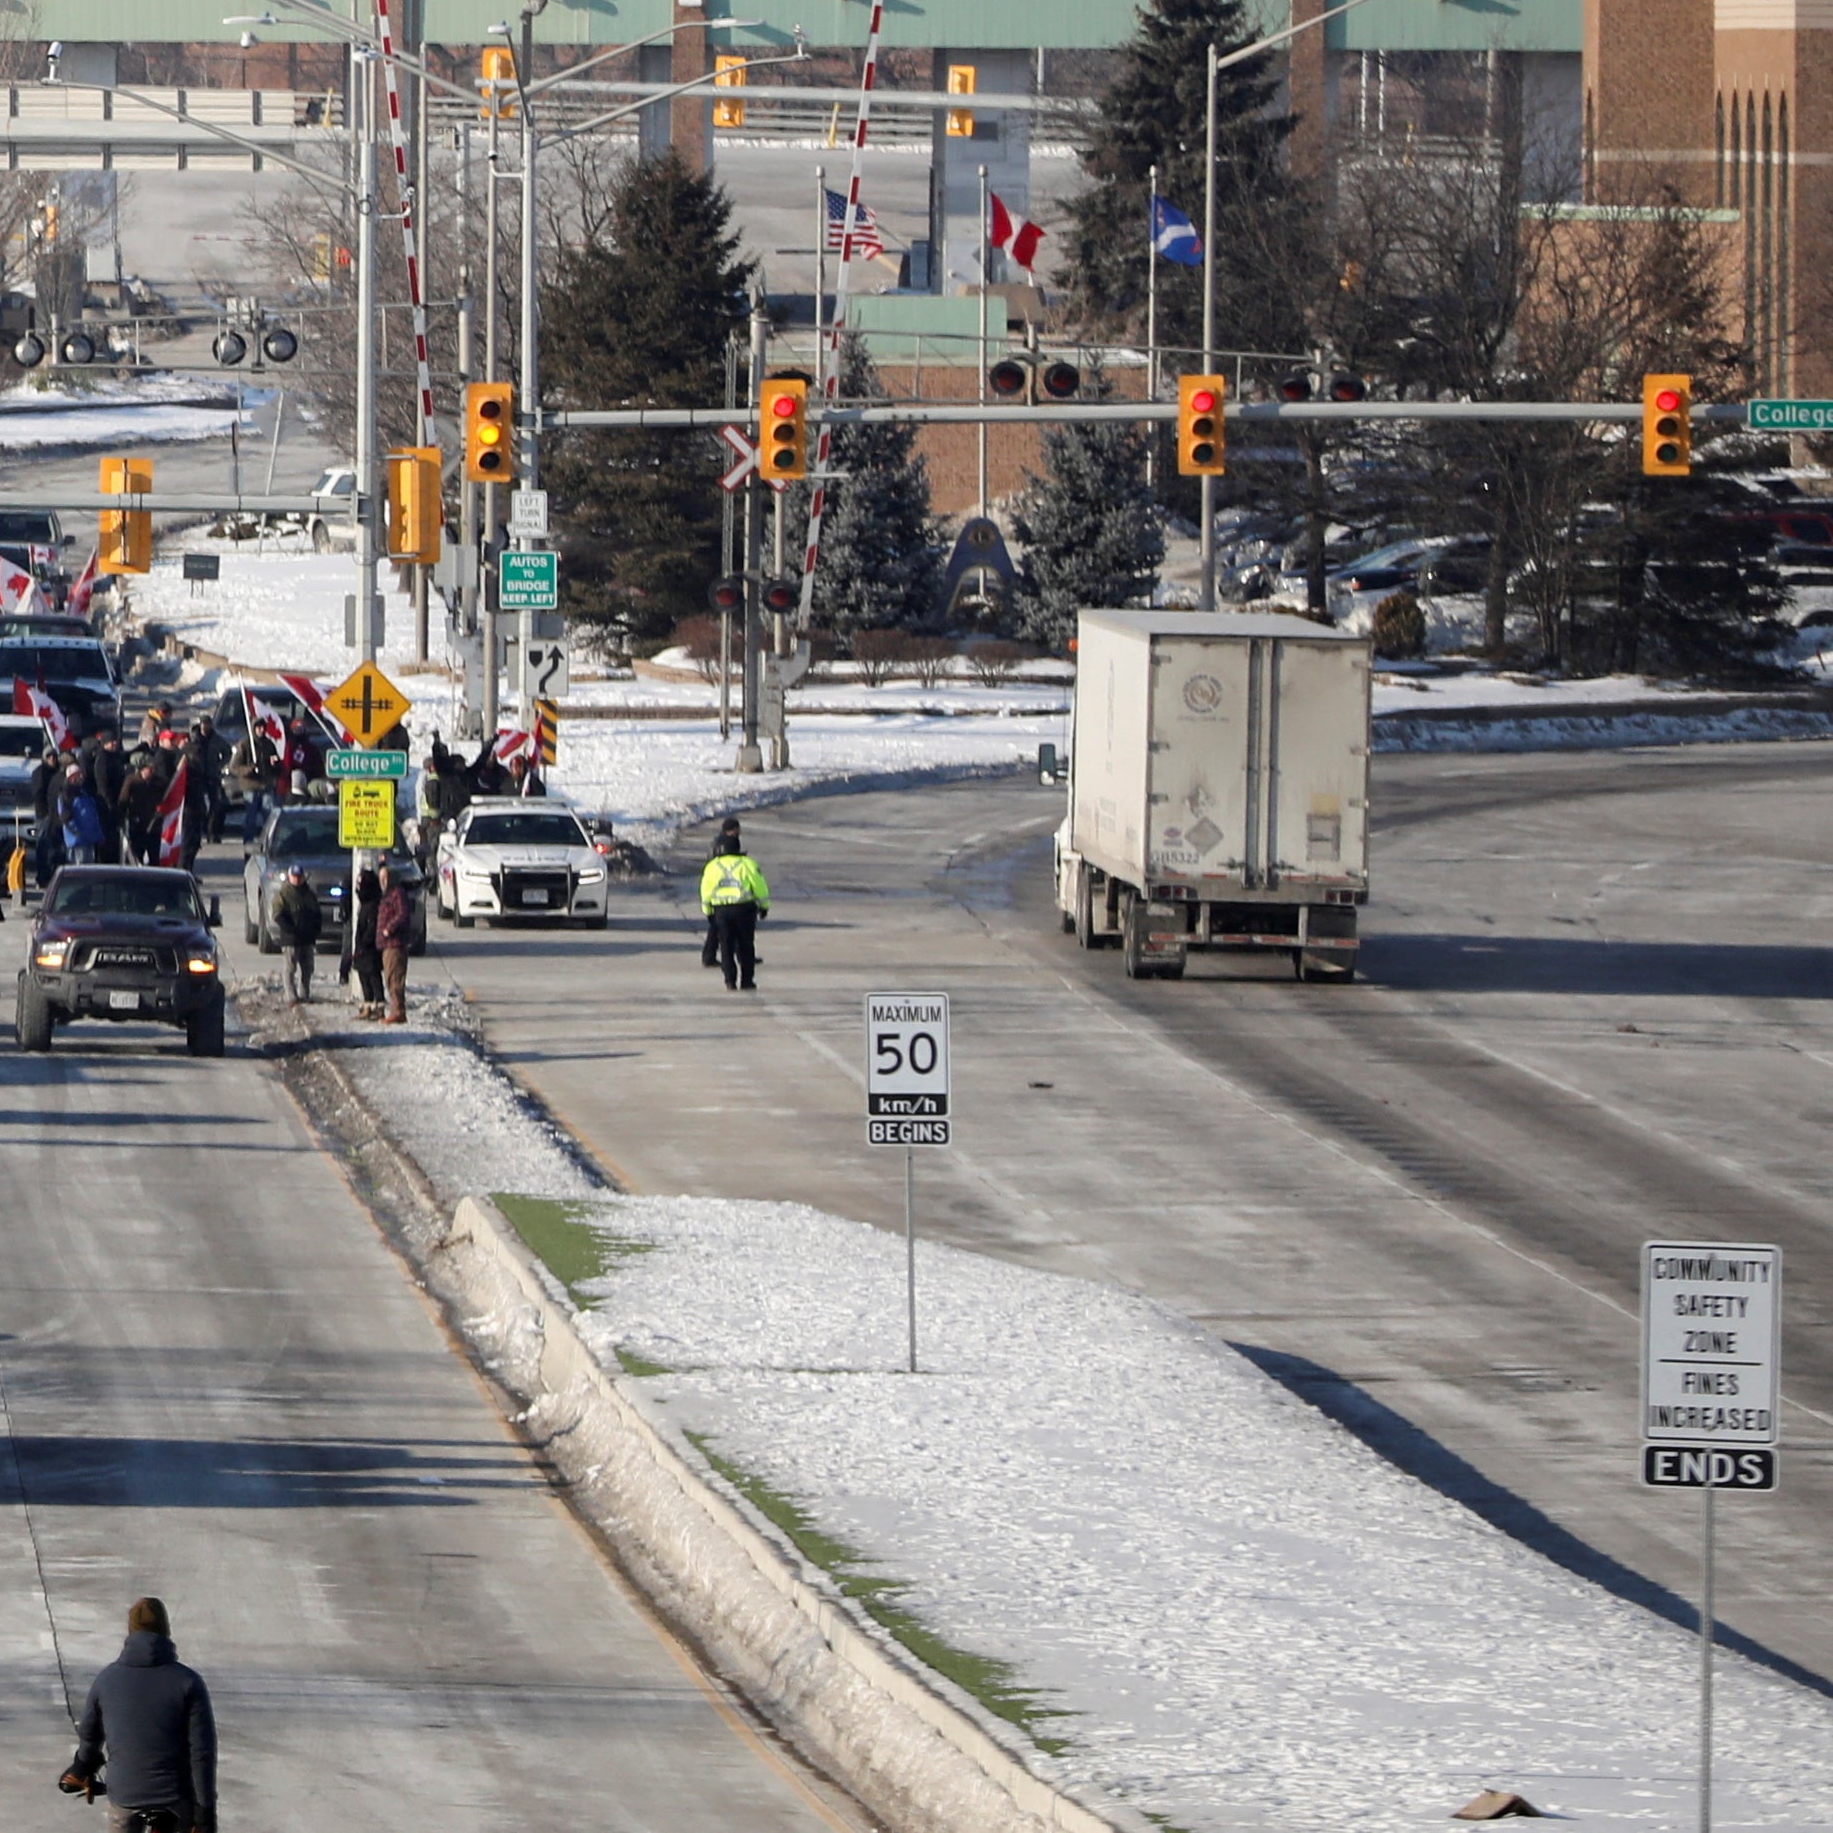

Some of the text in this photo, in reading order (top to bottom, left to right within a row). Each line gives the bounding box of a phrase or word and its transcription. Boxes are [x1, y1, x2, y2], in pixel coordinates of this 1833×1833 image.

[509, 556, 548, 568] AUTOS
[522, 569, 535, 579] TO
[506, 580, 550, 592] BRIDGE
[502, 593, 554, 604] KEEP LEFT
[329, 754, 390, 776] College
[872, 1006, 942, 1023] MAXIMUM
[876, 1032, 938, 1075] 50
[879, 1096, 937, 1114] km/h
[871, 1123, 946, 1142] BEGINS
[1653, 1257, 1771, 1283] COMMUNITY
[1674, 1294, 1749, 1318] SAFETY
[1683, 1331, 1737, 1353] ZONE
[1684, 1372, 1740, 1395] FINES
[1650, 1405, 1771, 1431] INCREASED
[1654, 1451, 1764, 1485] ENDS
